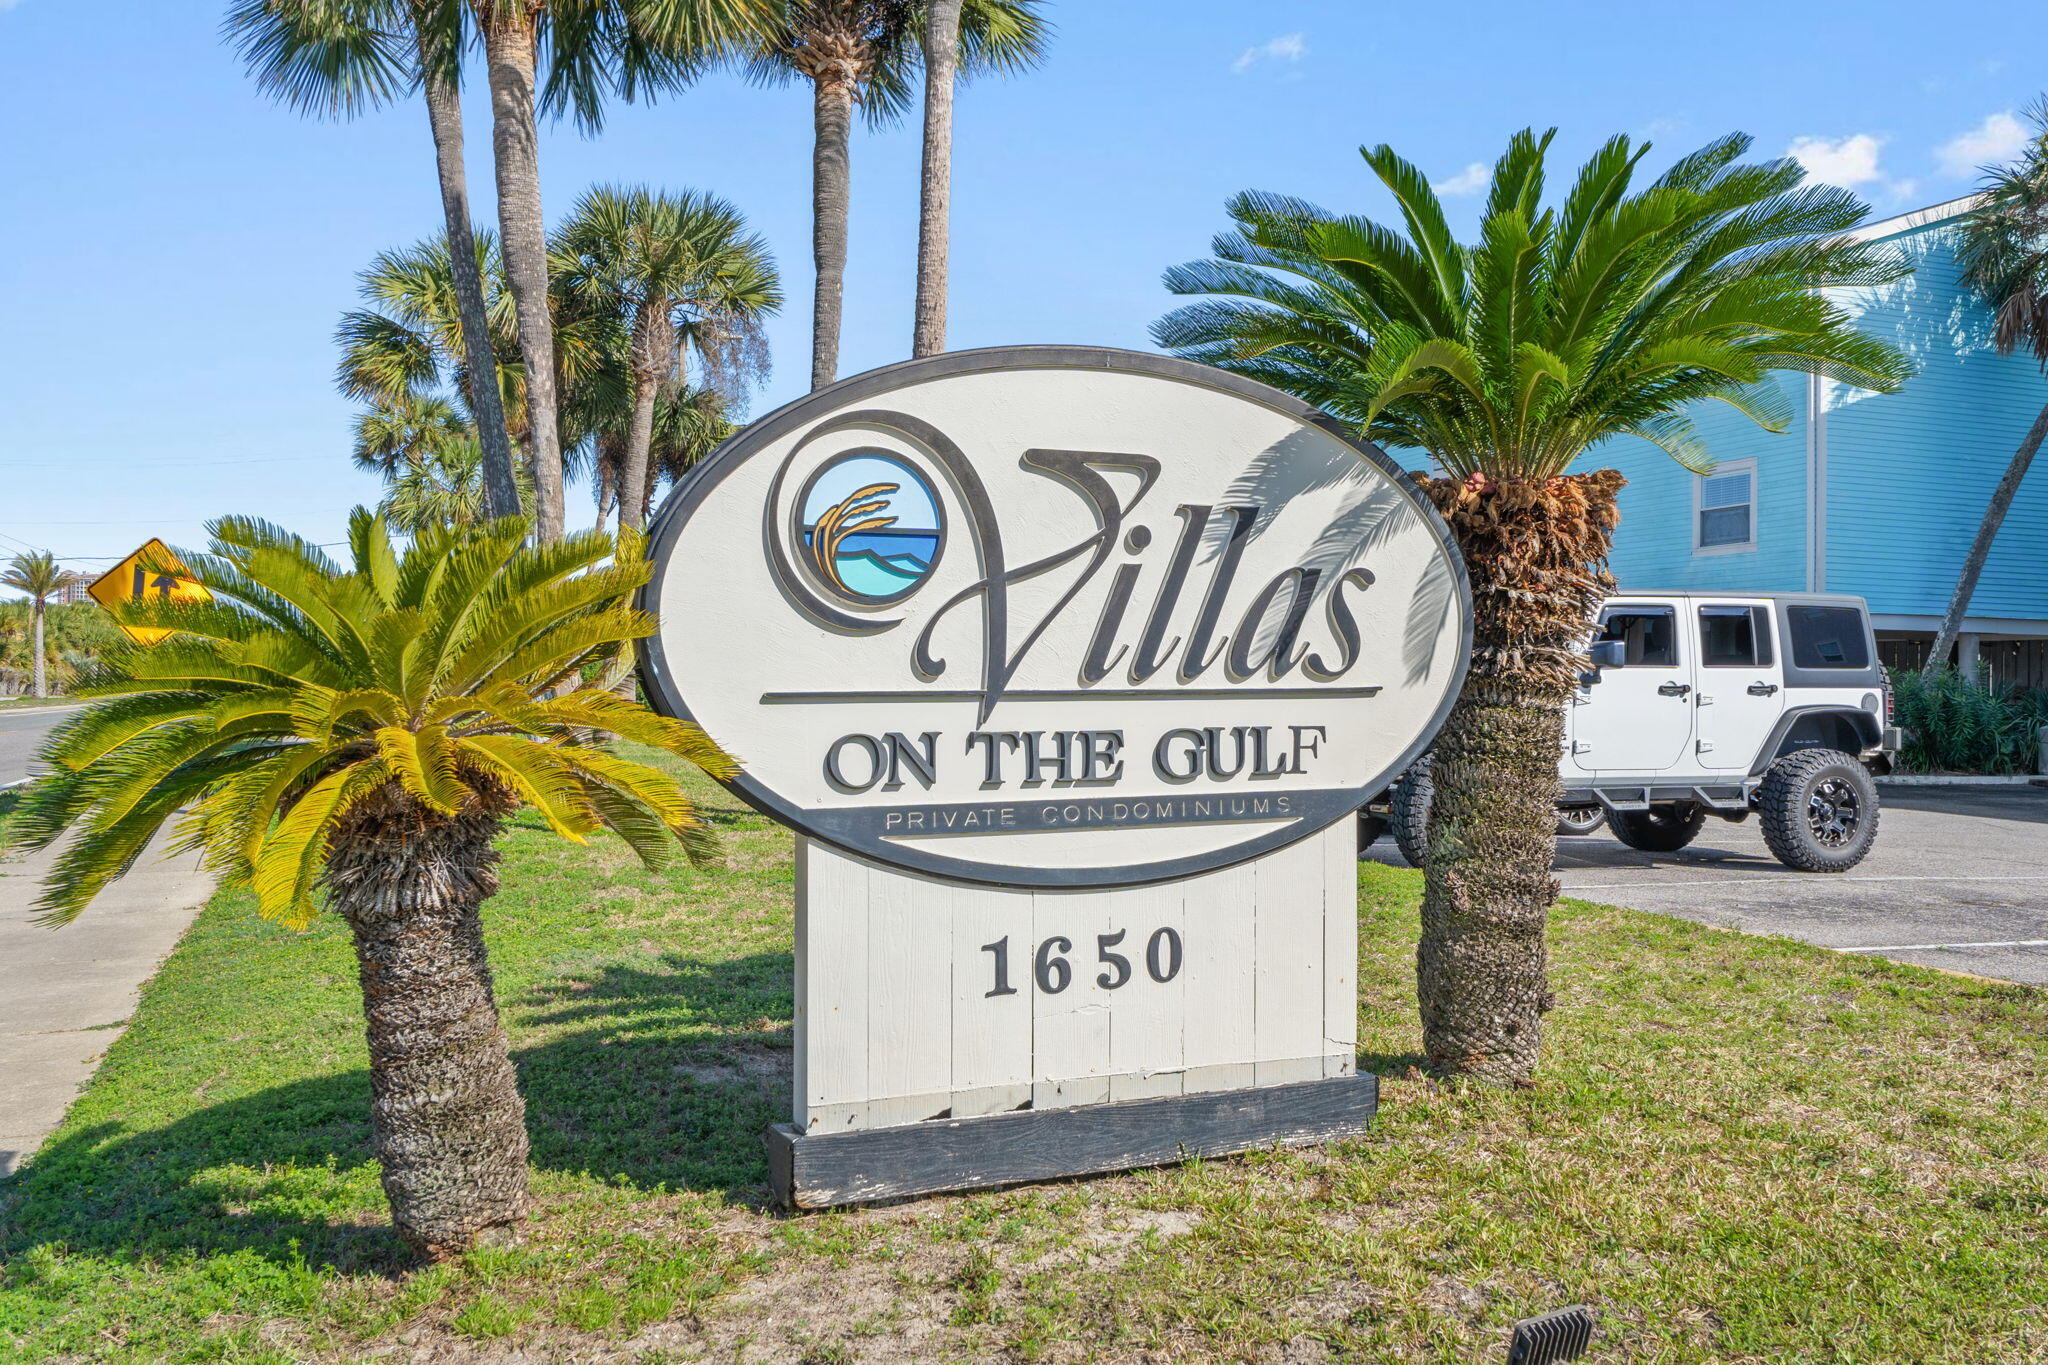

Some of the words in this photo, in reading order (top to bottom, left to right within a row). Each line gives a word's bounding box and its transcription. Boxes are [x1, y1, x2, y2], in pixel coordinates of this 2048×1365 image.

[910, 446, 1376, 728] Villas
[823, 730, 942, 794] ON
[965, 729, 1125, 791] THE
[1152, 725, 1327, 785] GULF
[886, 808, 1015, 830] PRIVATE
[1042, 796, 1291, 824] CONDOMINIUMS
[980, 926, 1183, 998] 1650
